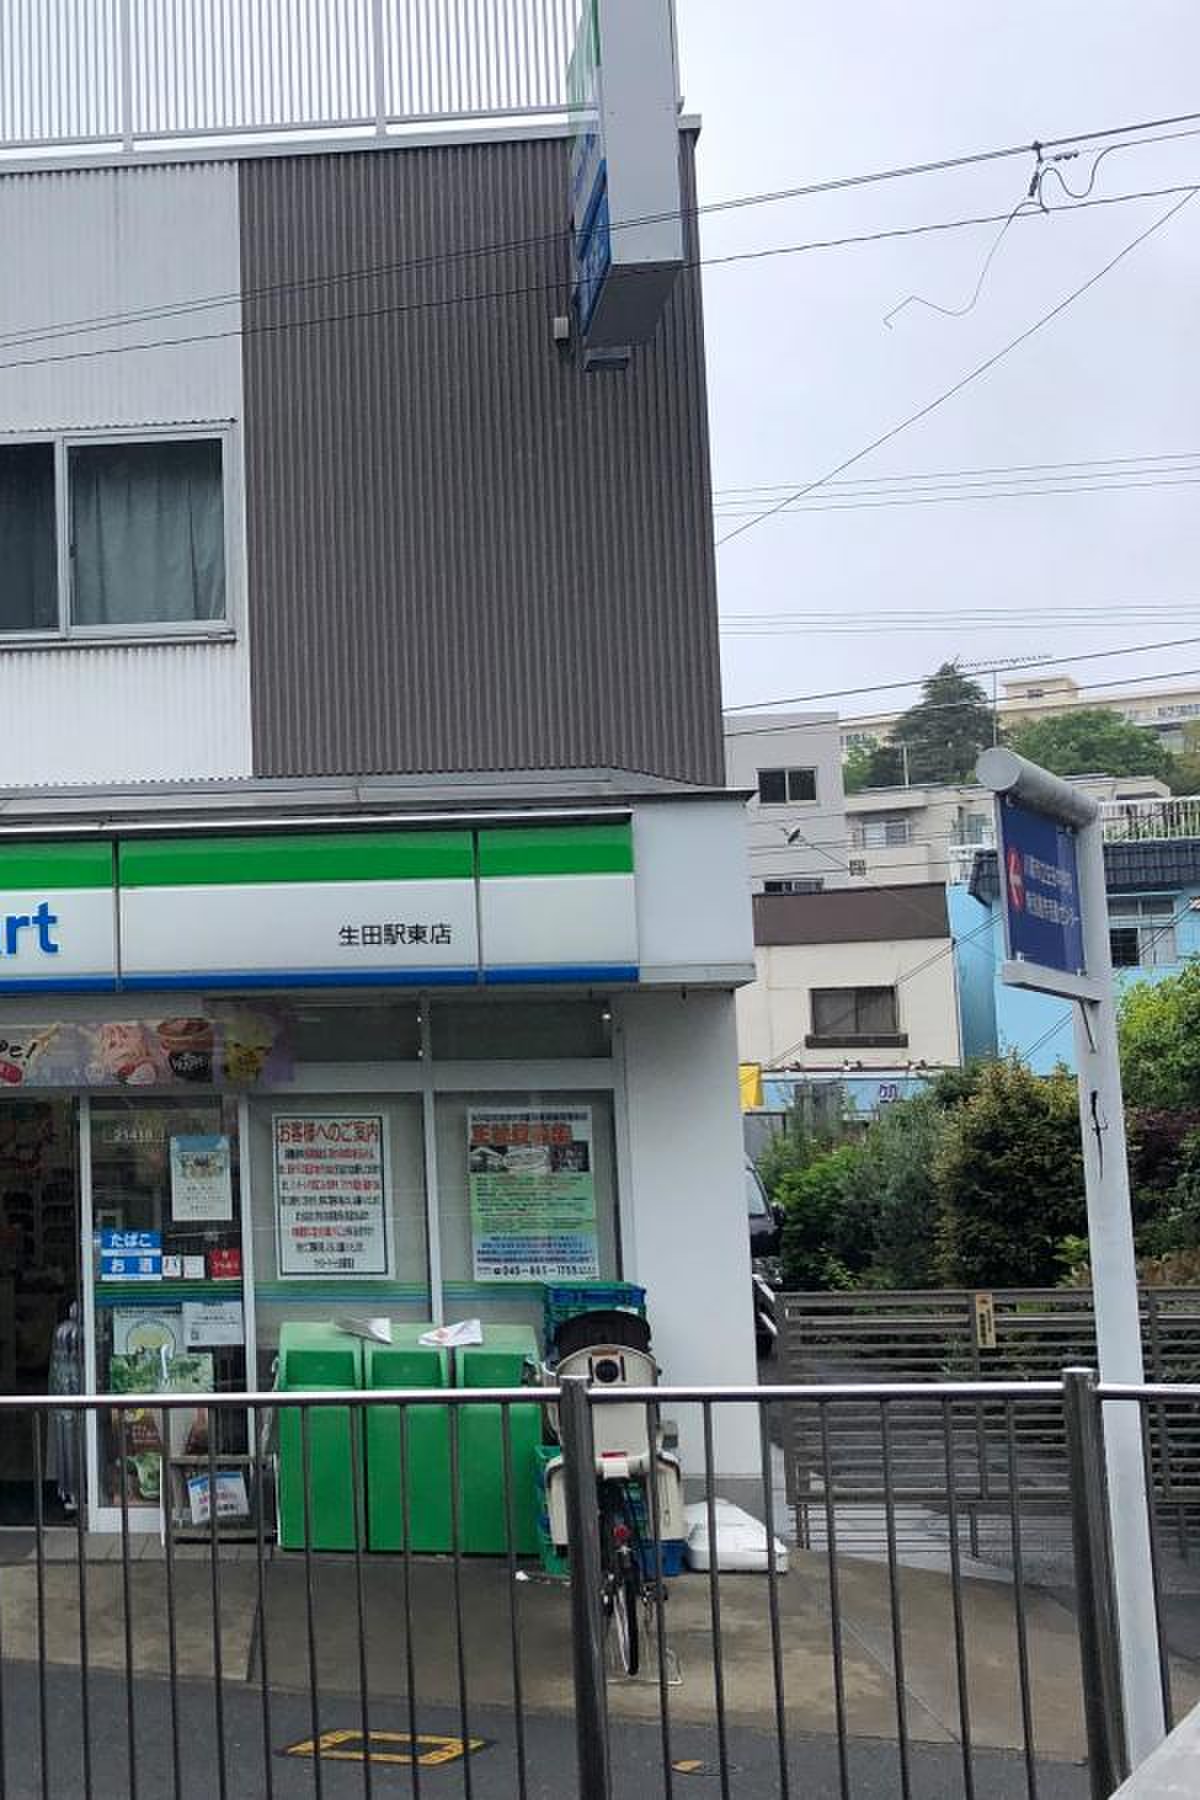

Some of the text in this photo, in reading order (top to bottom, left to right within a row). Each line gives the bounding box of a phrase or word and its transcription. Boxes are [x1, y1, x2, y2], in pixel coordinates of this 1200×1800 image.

[338, 923, 452, 945] 生田駅東店
[111, 1232, 152, 1248] たばこ
